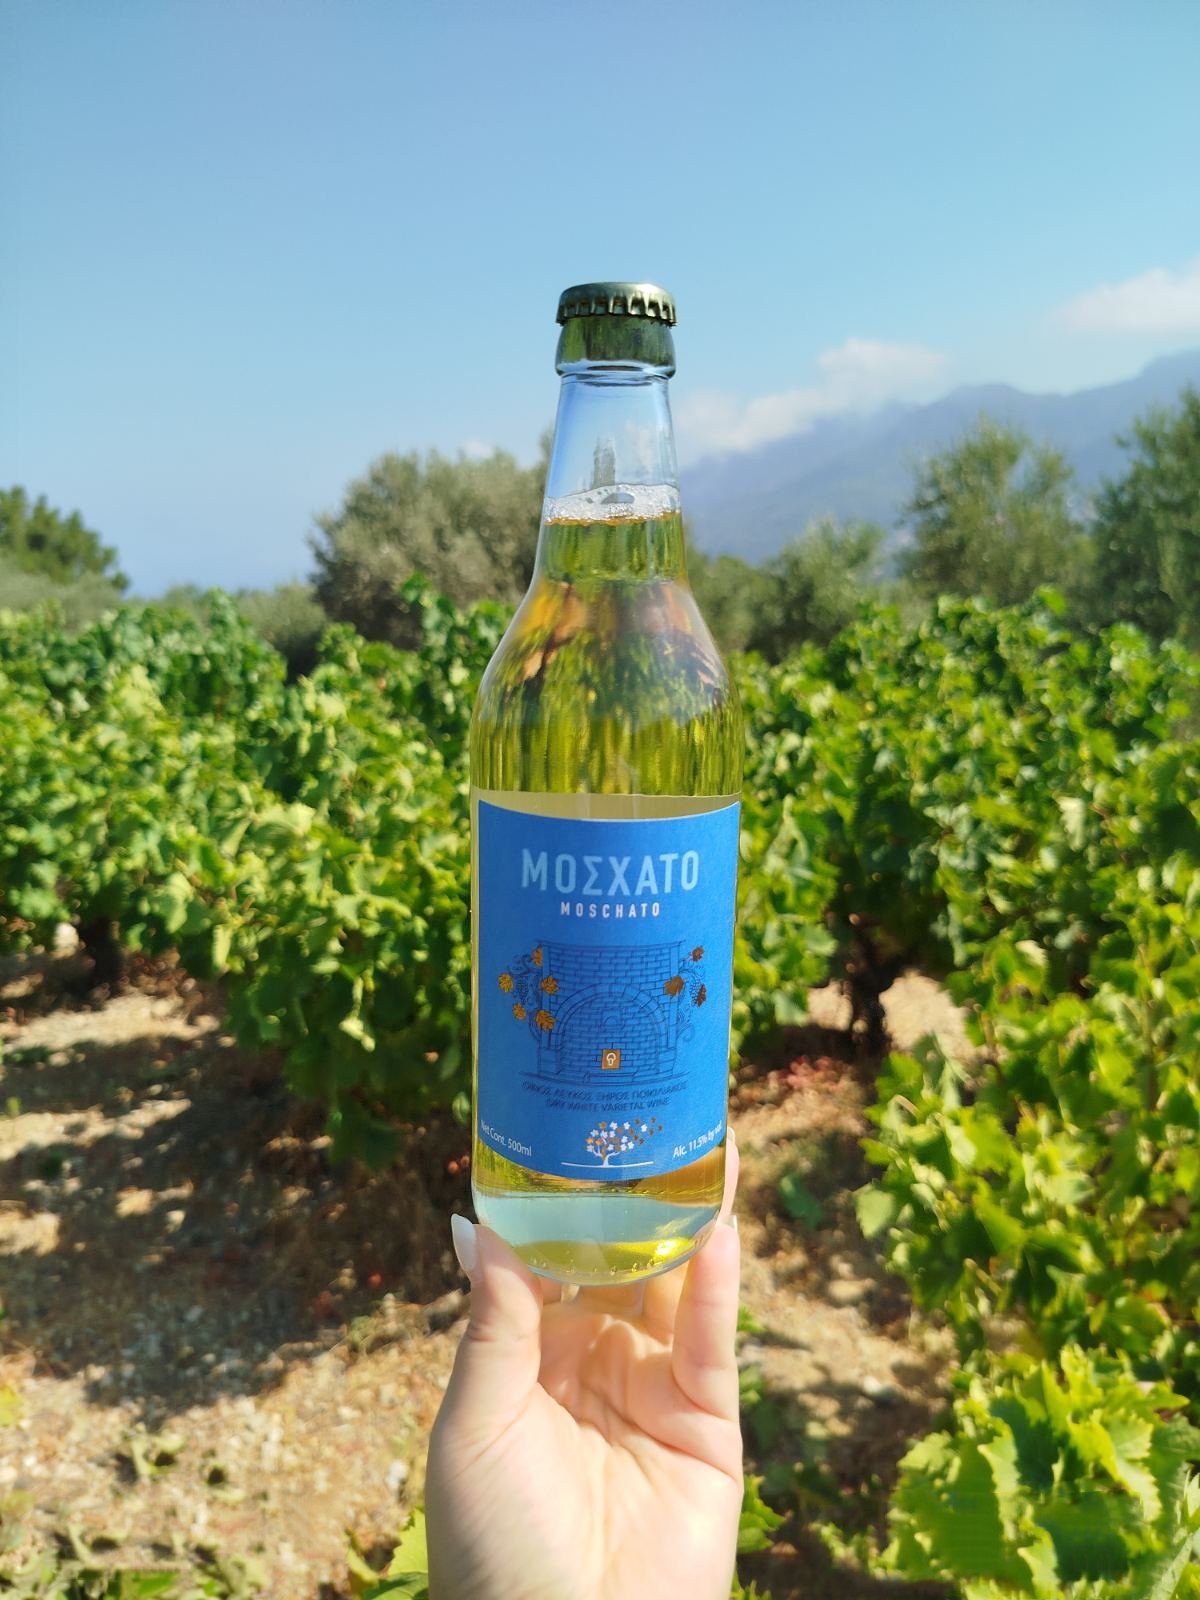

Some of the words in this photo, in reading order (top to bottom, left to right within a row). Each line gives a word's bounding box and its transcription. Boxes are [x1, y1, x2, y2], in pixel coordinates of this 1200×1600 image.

[521, 848, 700, 896] ΜΟΣΧΑΤΟ
[561, 901, 660, 918] MOSCHATO
[567, 1101, 598, 1112] WHITE
[601, 1102, 645, 1112] VARIETAL
[646, 1096, 670, 1109] WINE
[508, 1137, 532, 1157] 500ml
